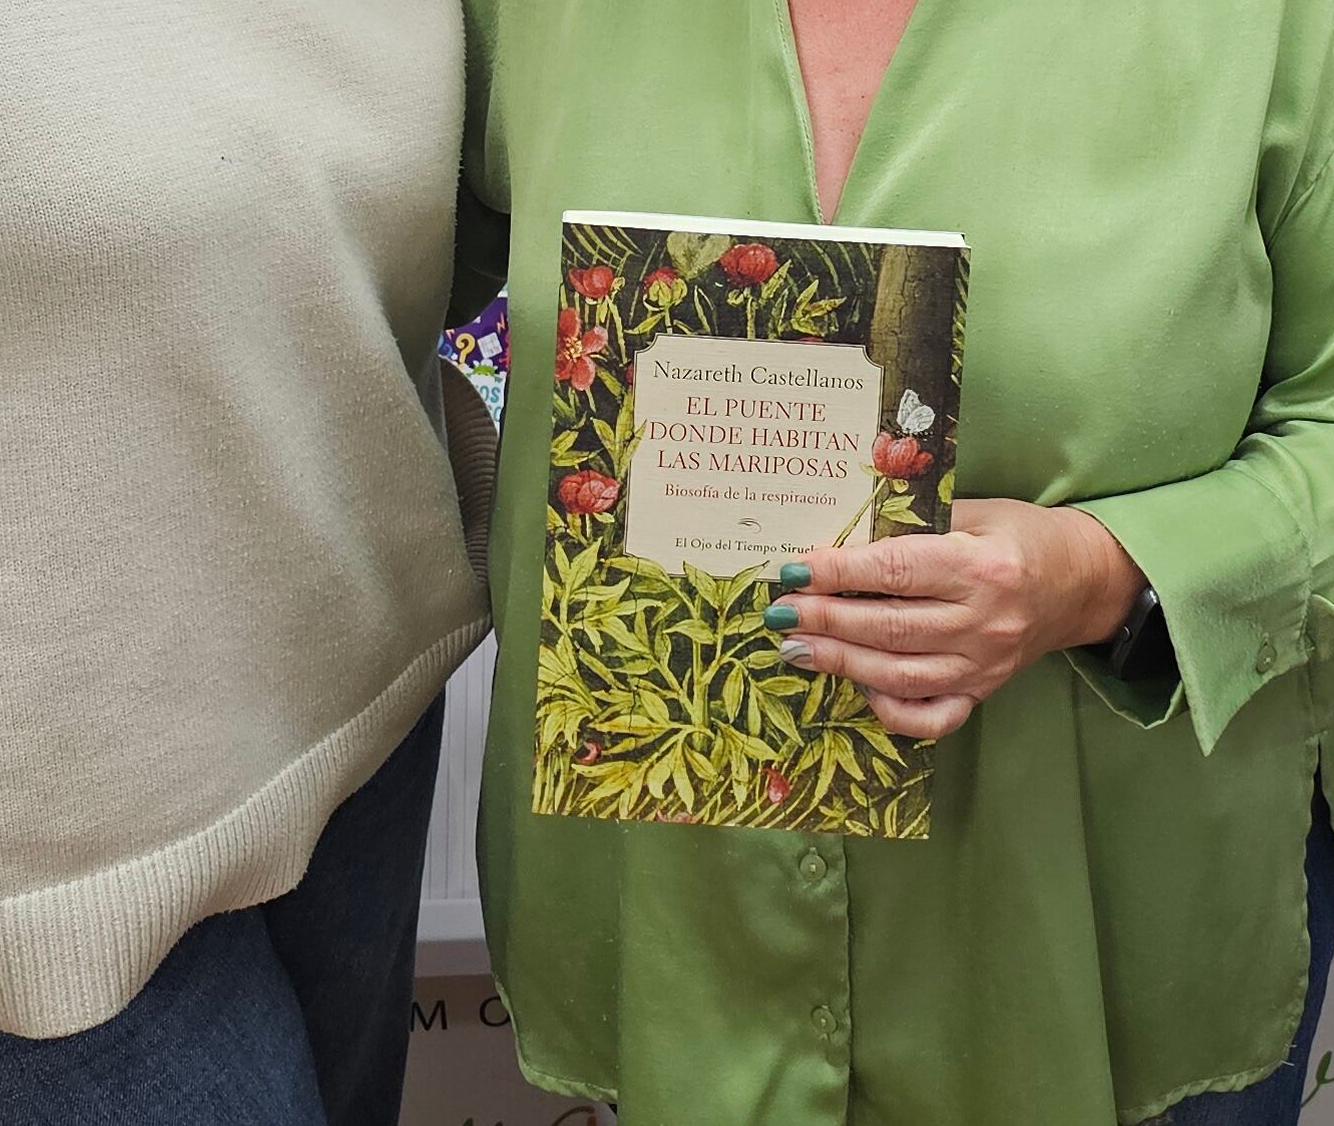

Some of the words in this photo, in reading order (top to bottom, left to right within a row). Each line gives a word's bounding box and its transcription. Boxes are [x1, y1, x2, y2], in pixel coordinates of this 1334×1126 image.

[652, 360, 743, 385] Nazareth
[749, 365, 865, 392] Castellanos
[686, 396, 719, 416] EL
[724, 398, 827, 422] PUENTE
[648, 421, 743, 446] DONDE
[751, 427, 860, 452] HABITAN
[657, 449, 701, 471] LAS
[709, 452, 849, 480] MARIPOSAS
[724, 485, 741, 501] de
[744, 487, 757, 502] la
[761, 490, 837, 508] respiración
[675, 537, 688, 549] El
[690, 538, 713, 553] Ojo
[715, 539, 732, 551] del
[734, 540, 778, 555] Tiempo
[780, 542, 818, 555] Siruel
